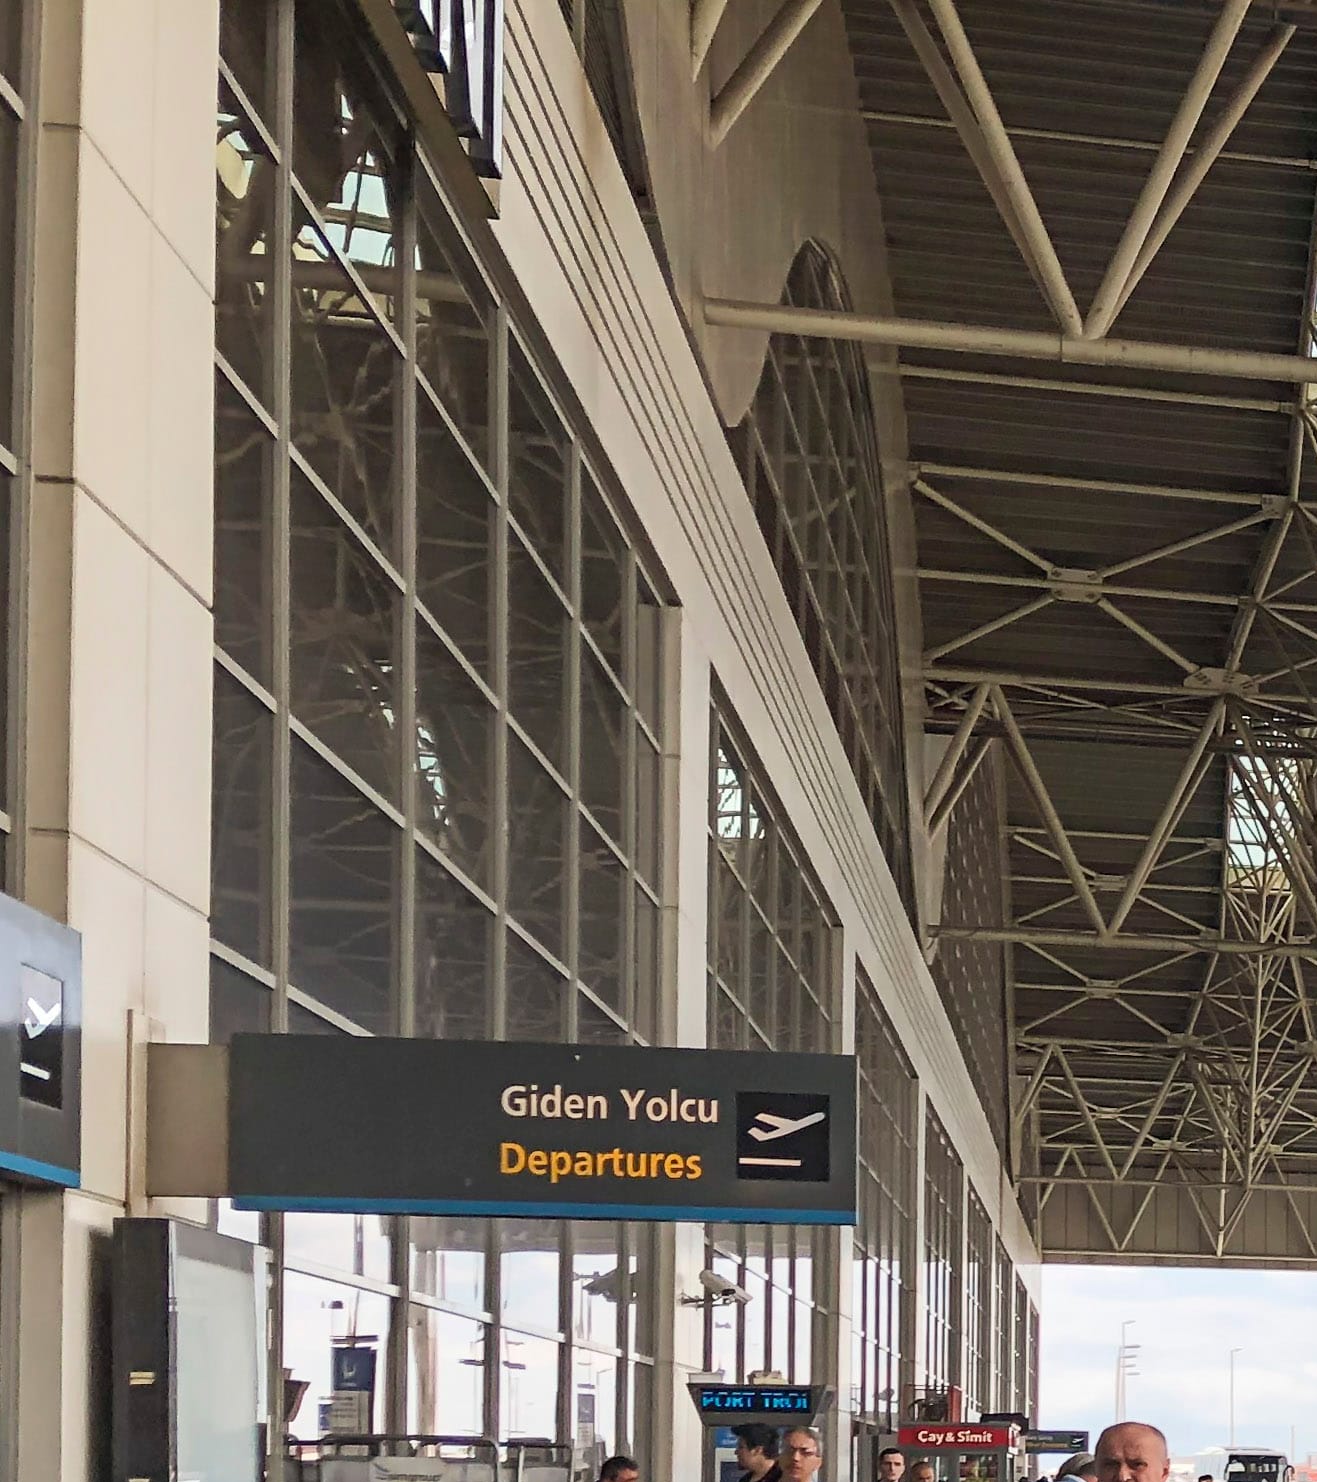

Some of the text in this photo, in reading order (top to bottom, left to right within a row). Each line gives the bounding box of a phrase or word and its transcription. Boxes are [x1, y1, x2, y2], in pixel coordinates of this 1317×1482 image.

[501, 1084, 719, 1123] Giden Yolcu
[500, 1142, 702, 1183] Departures
[945, 1431, 955, 1443] &
[957, 1429, 993, 1443] Simit
